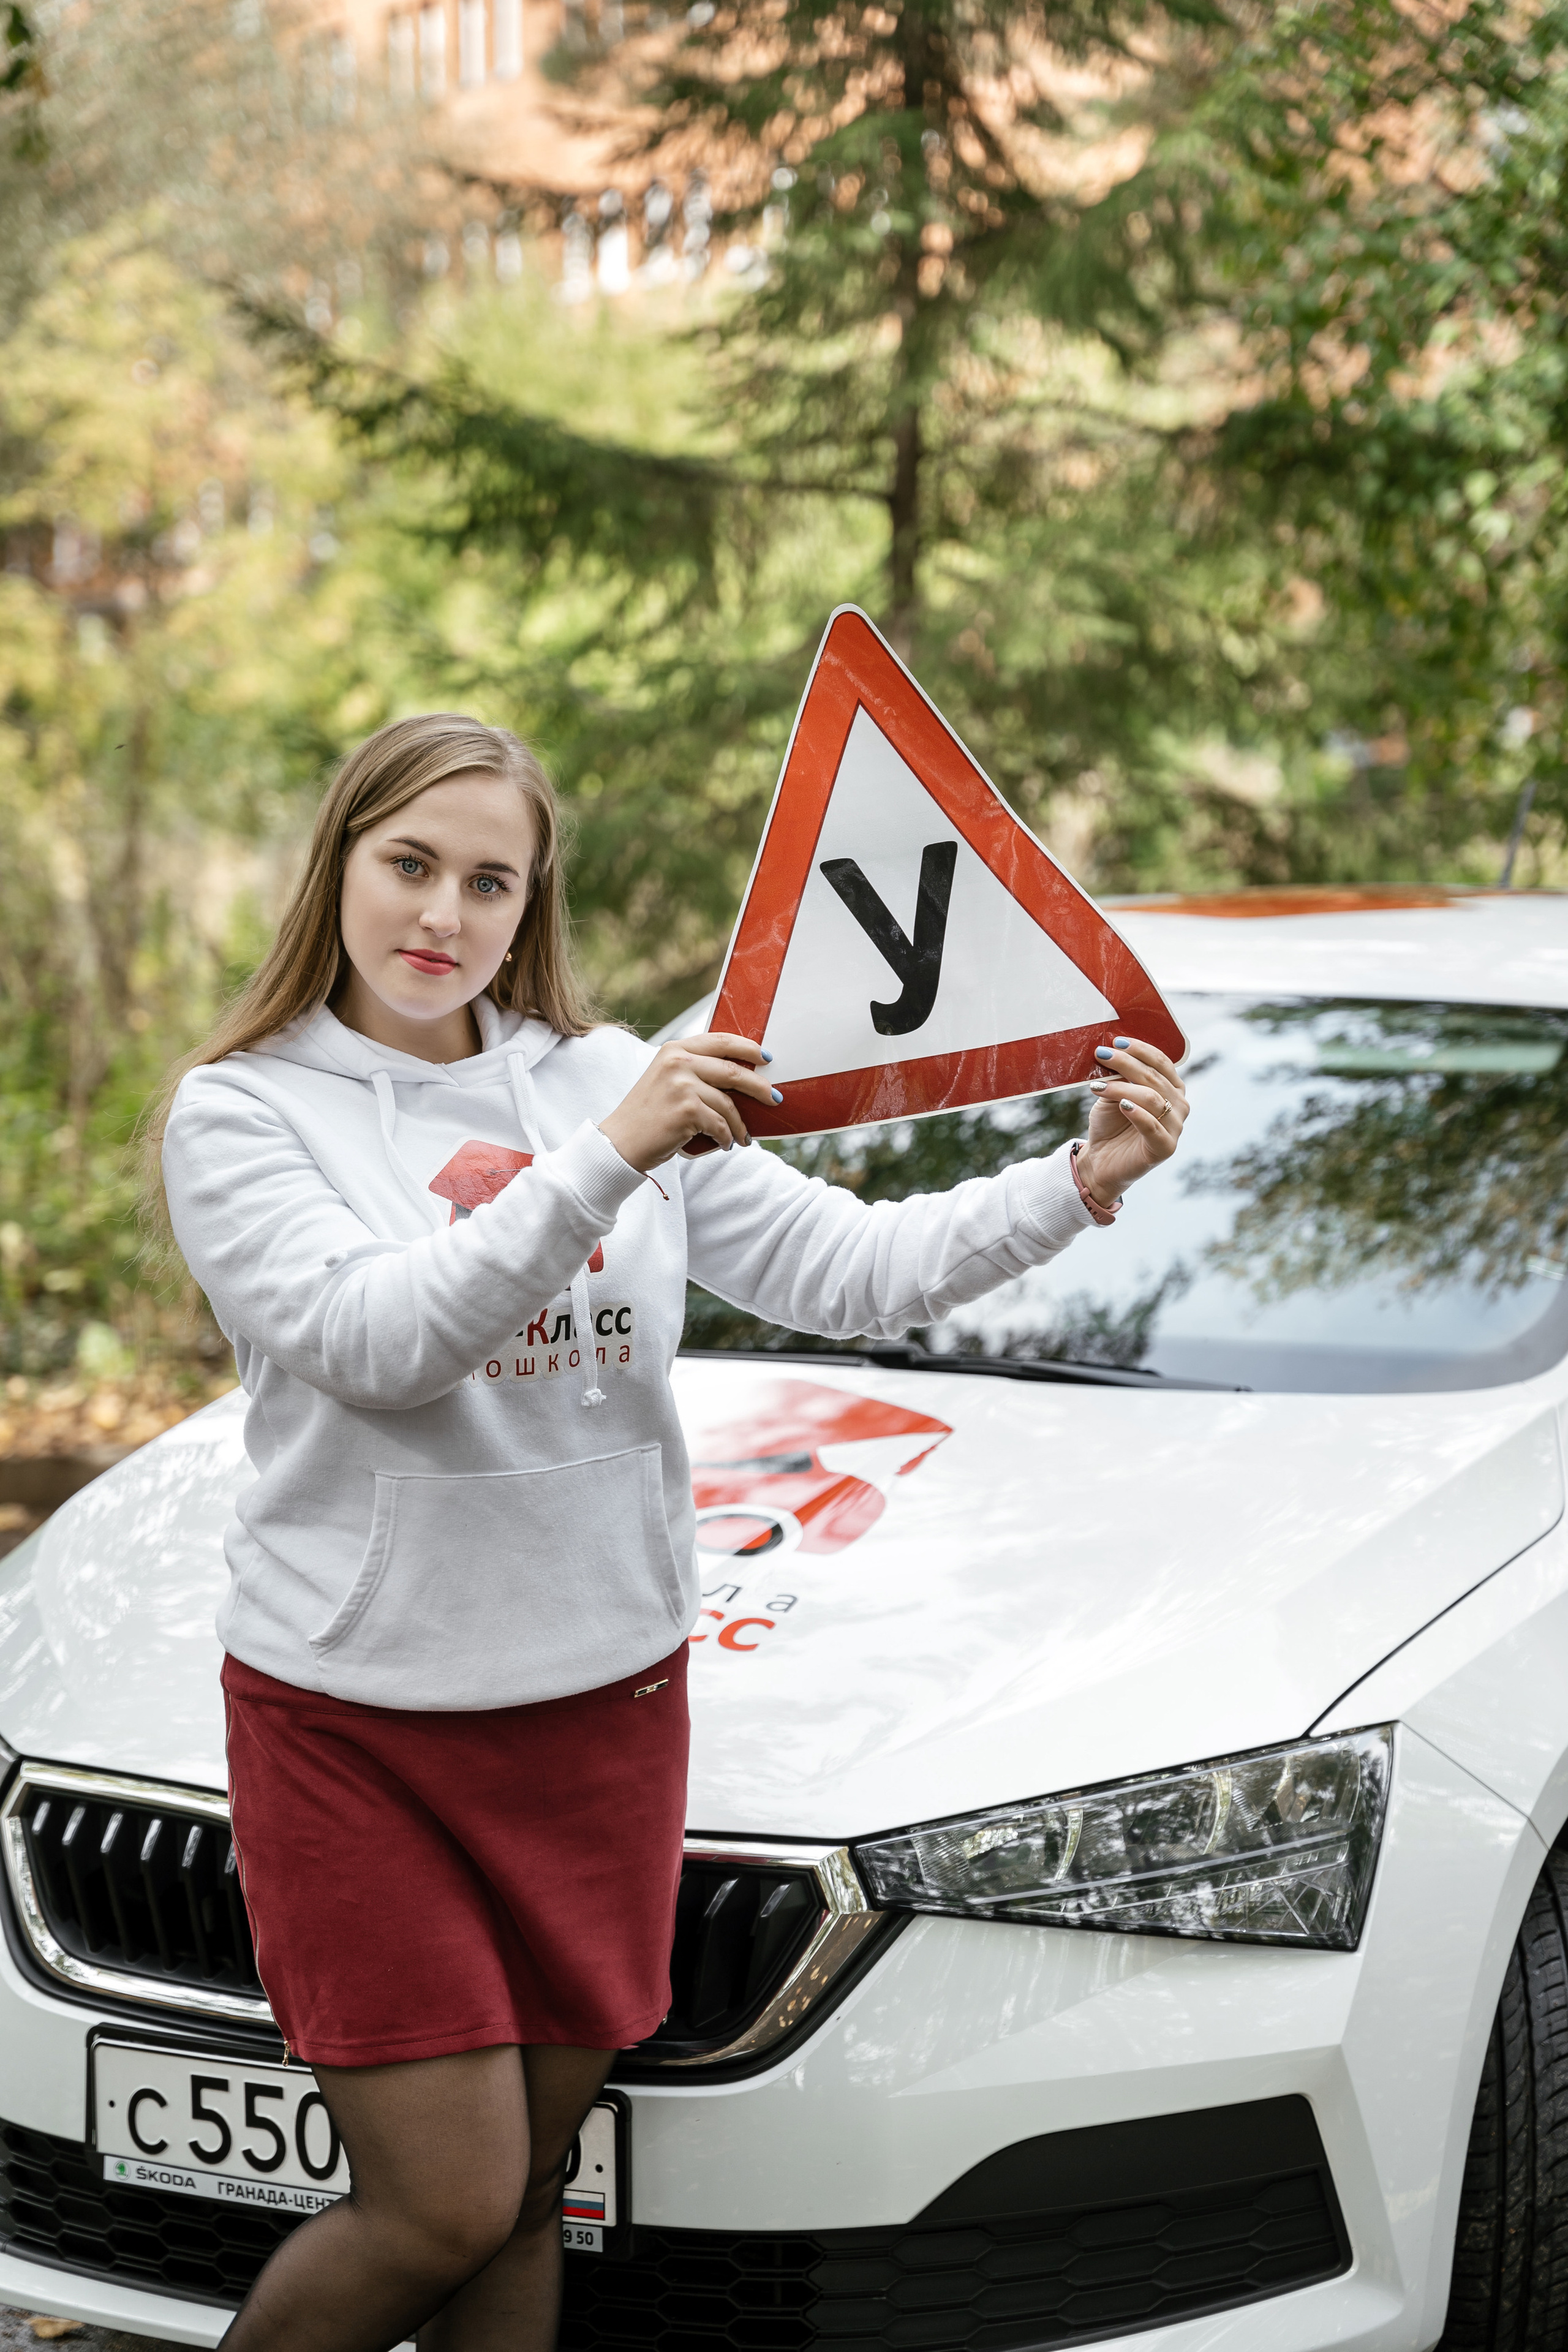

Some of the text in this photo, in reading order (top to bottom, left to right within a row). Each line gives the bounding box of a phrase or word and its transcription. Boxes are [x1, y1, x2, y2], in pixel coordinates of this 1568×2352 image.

[819, 840, 958, 1036] У
[515, 1306, 631, 1347] Клсс
[470, 1344, 630, 1380] ошкола
[136, 2166, 197, 2189] ŠKODA
[217, 2181, 334, 2210] ГРАНАДА-ЦЕНТ
[564, 2229, 572, 2244] 9
